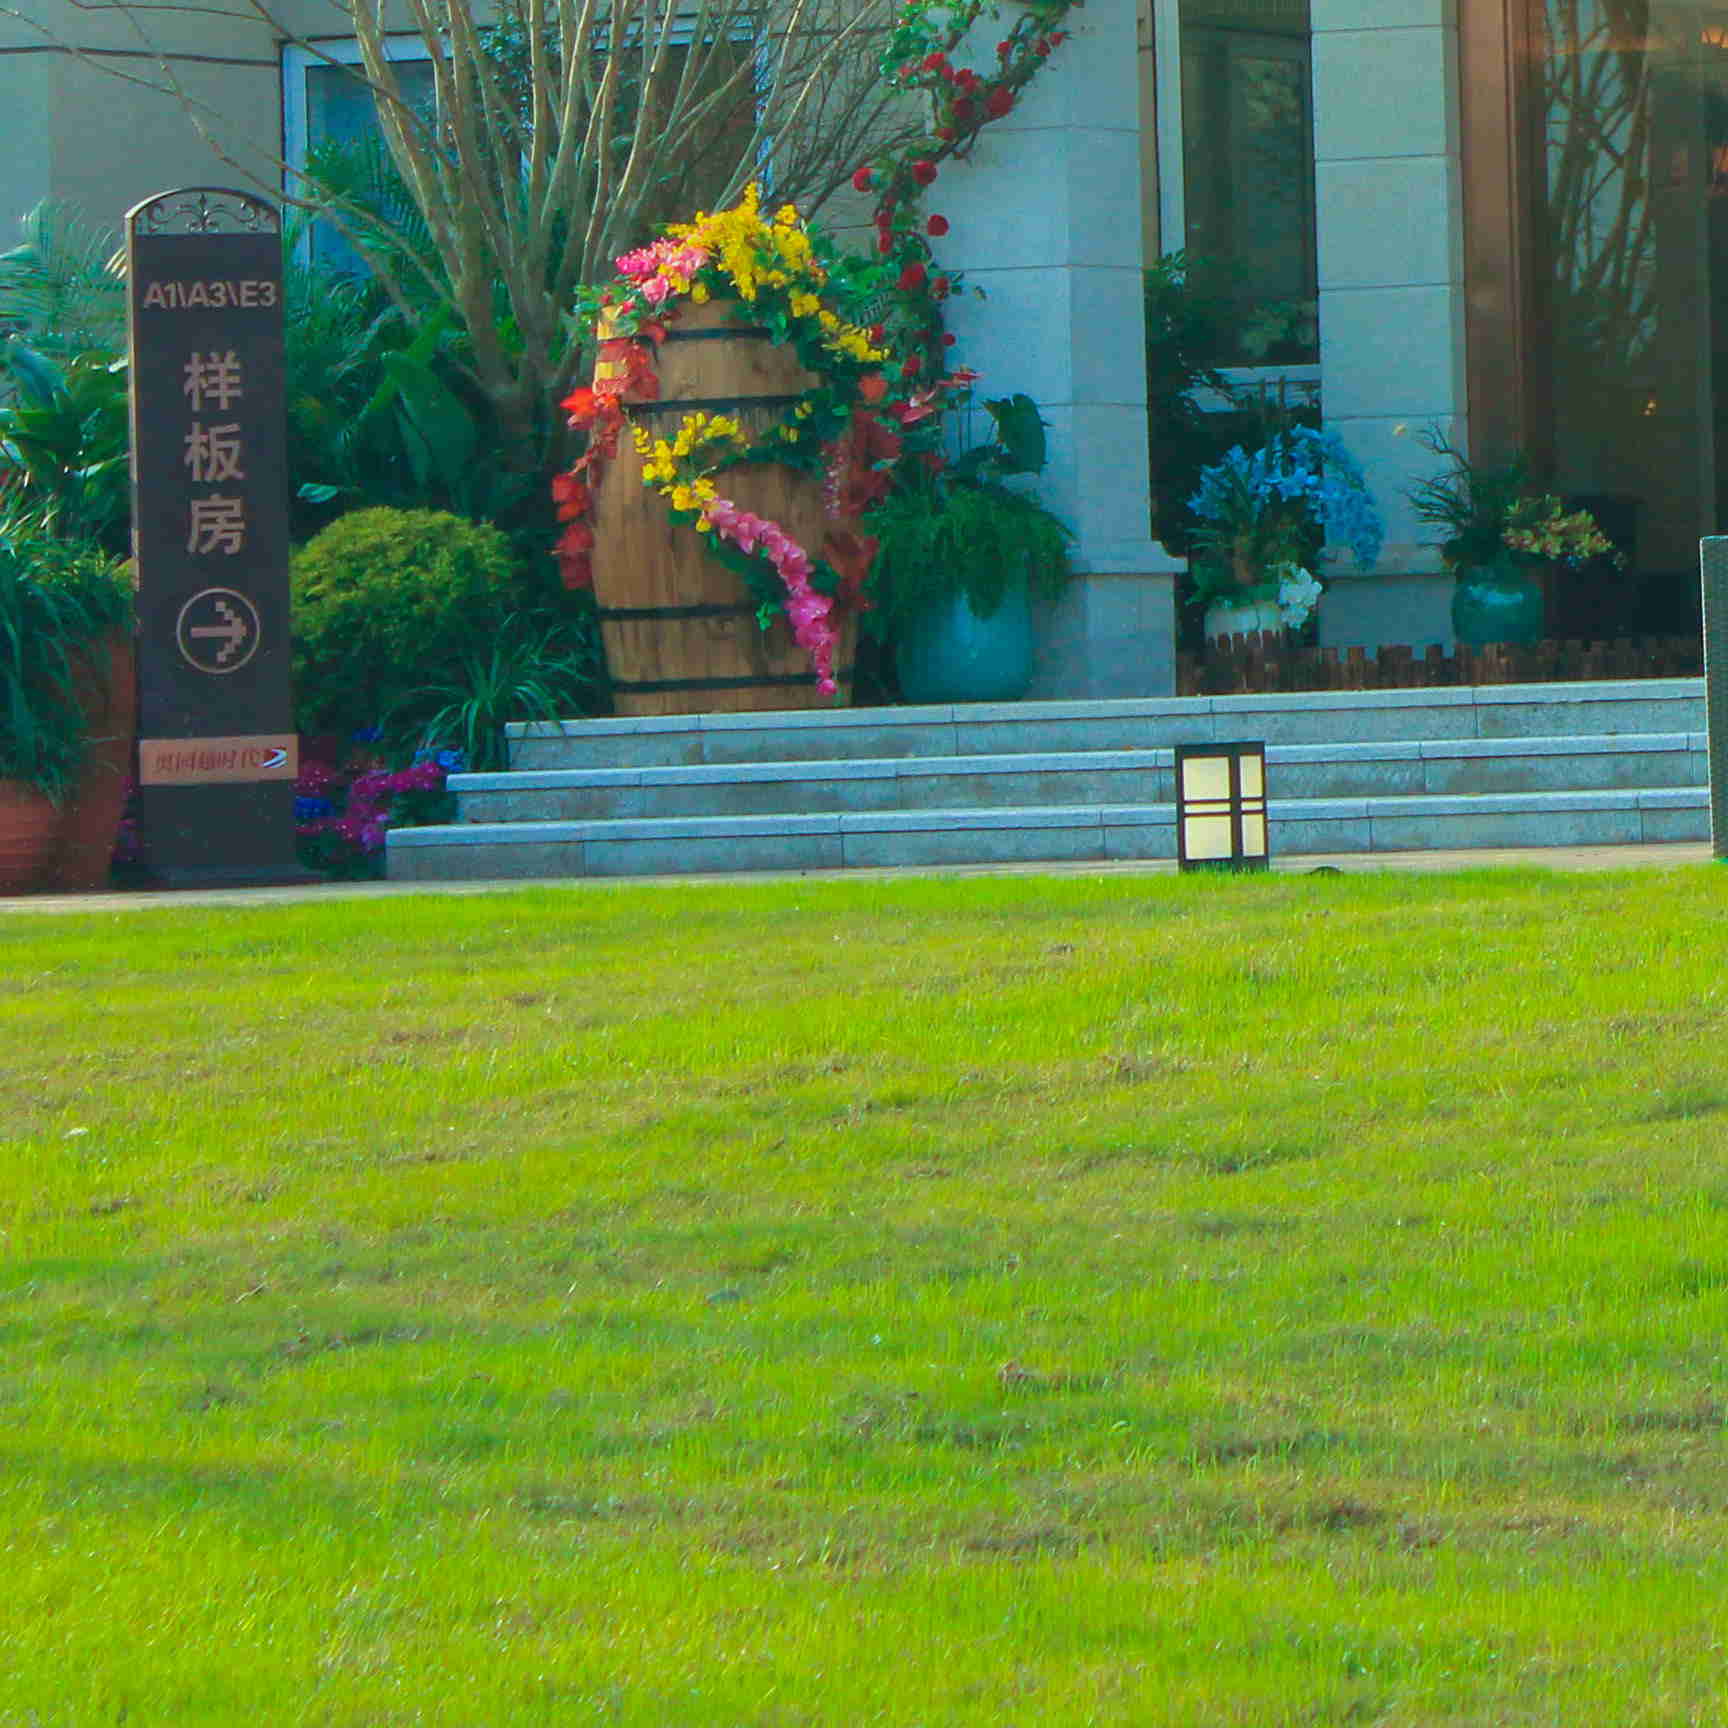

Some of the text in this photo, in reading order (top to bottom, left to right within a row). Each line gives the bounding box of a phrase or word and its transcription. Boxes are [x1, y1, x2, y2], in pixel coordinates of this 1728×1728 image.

[143, 280, 278, 309] A1\A3\E3
[183, 351, 245, 557] 样板房
